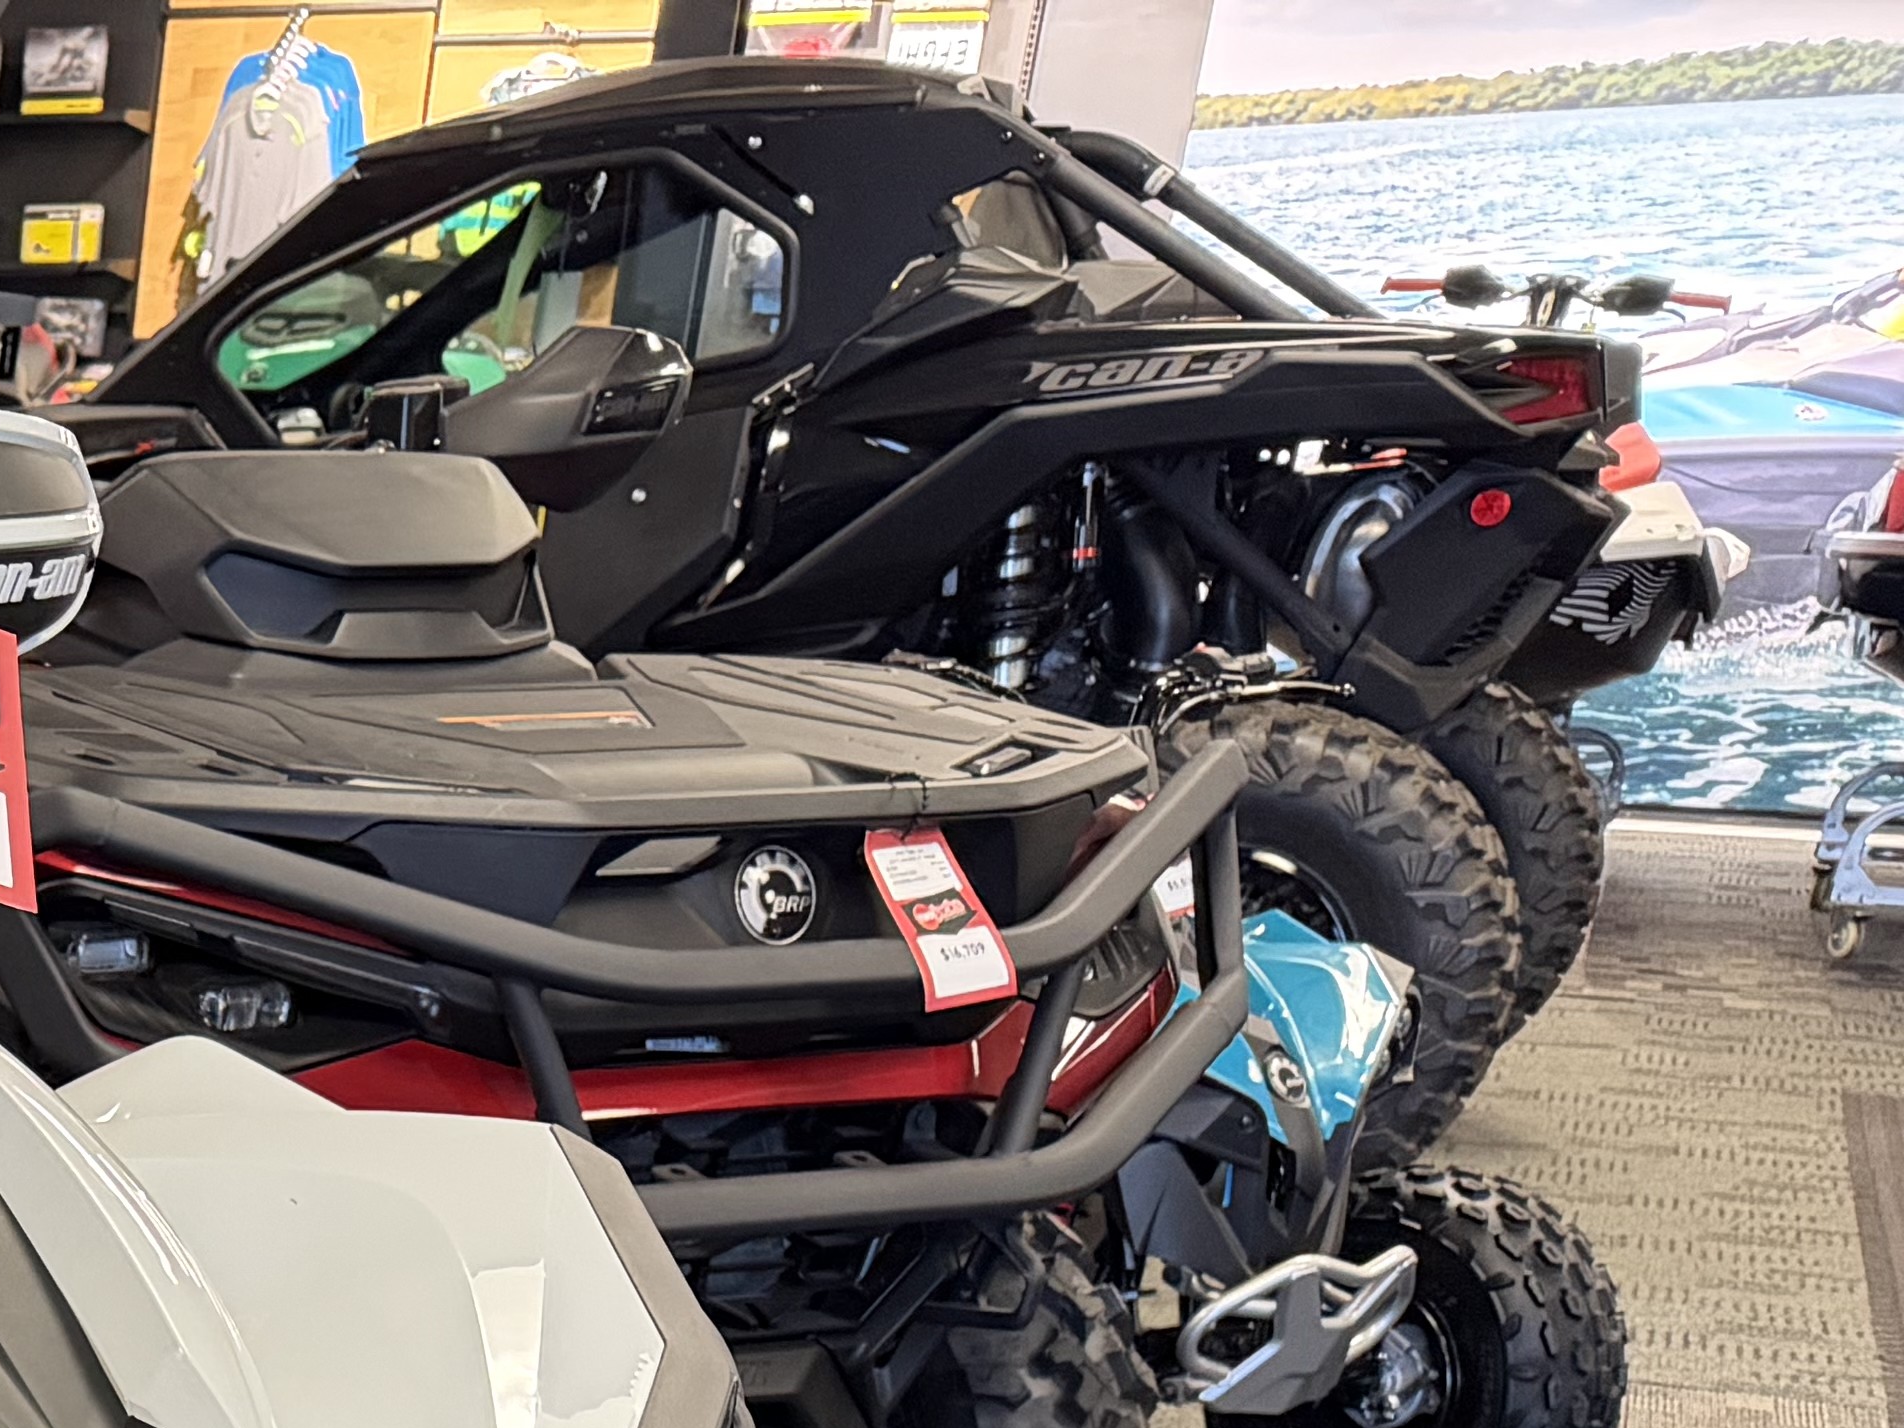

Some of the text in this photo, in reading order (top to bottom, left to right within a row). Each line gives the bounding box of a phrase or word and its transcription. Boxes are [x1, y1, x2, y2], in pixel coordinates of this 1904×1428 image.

[1040, 350, 1265, 391] can-a
[773, 896, 810, 913] BRP
[940, 942, 985, 961] $16,709
